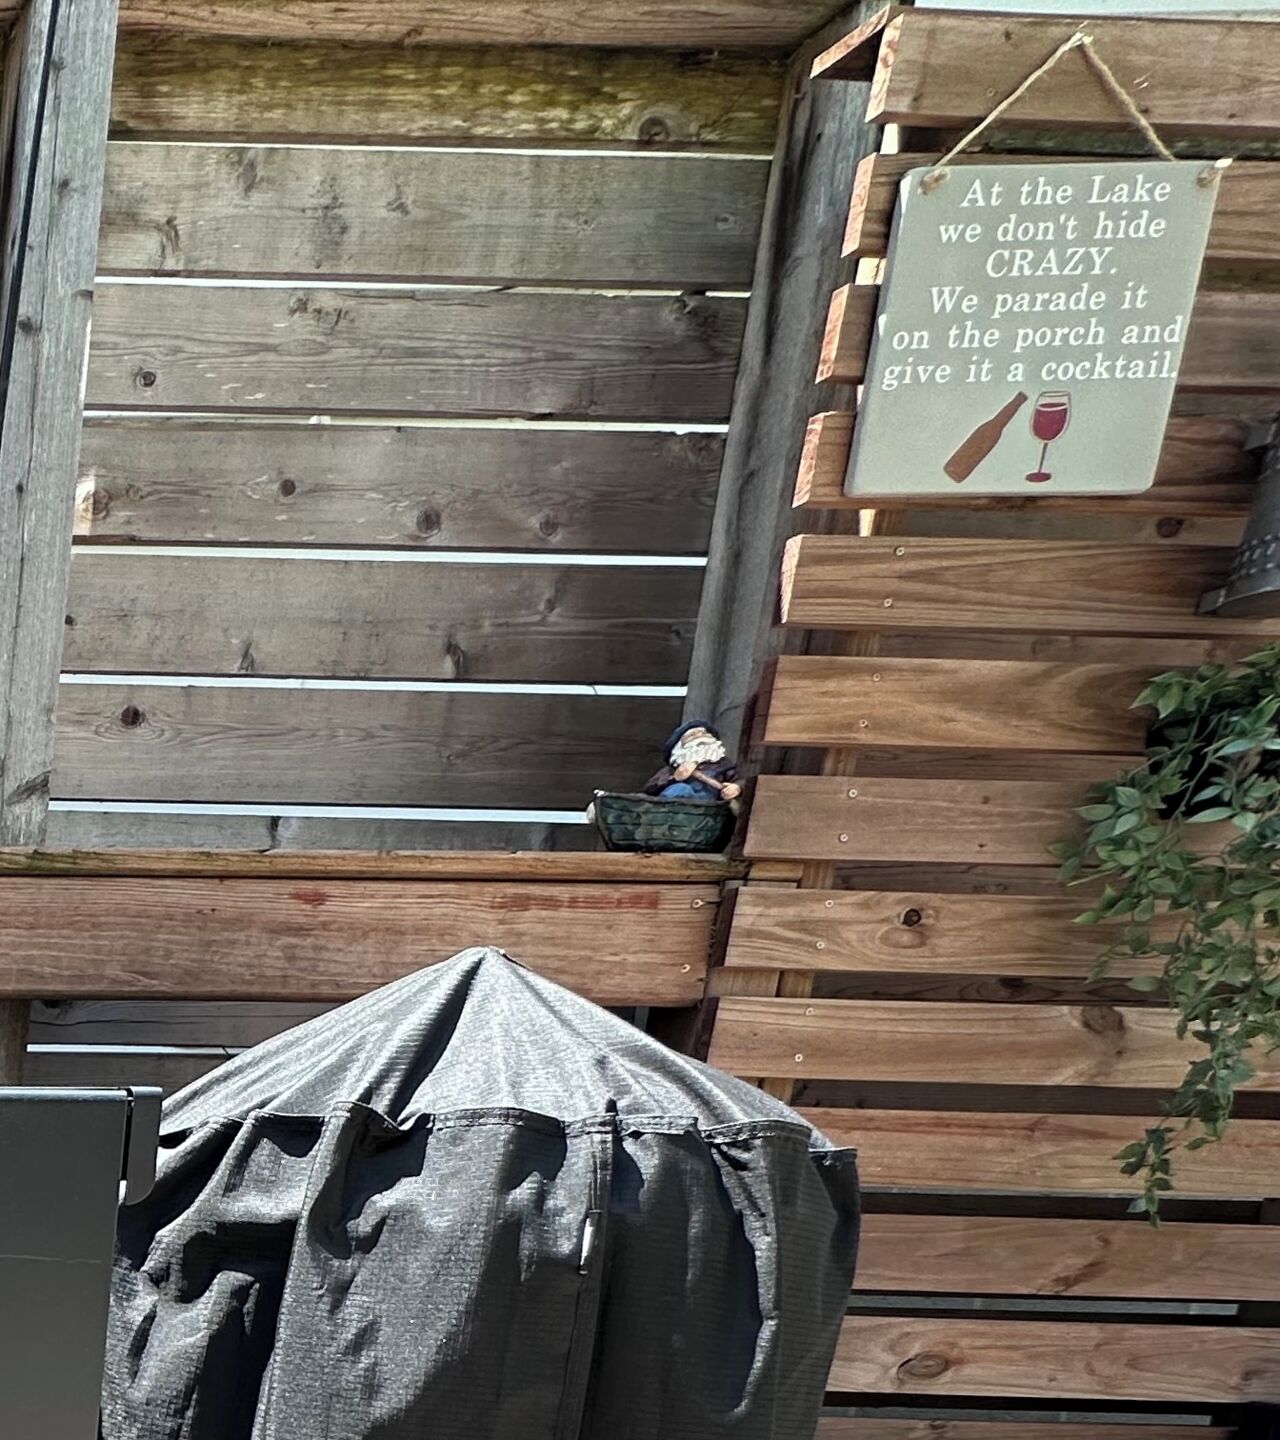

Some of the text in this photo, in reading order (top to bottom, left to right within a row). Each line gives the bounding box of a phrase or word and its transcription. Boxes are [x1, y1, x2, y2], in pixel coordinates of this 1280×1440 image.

[959, 175, 1171, 207] At the Lake
[939, 210, 1167, 244] we don't hide
[986, 247, 1117, 277] CRAZY.
[930, 282, 1148, 318] We parade it
[892, 316, 1184, 352] on the porch and
[882, 352, 1178, 390] give it a cocktail.
